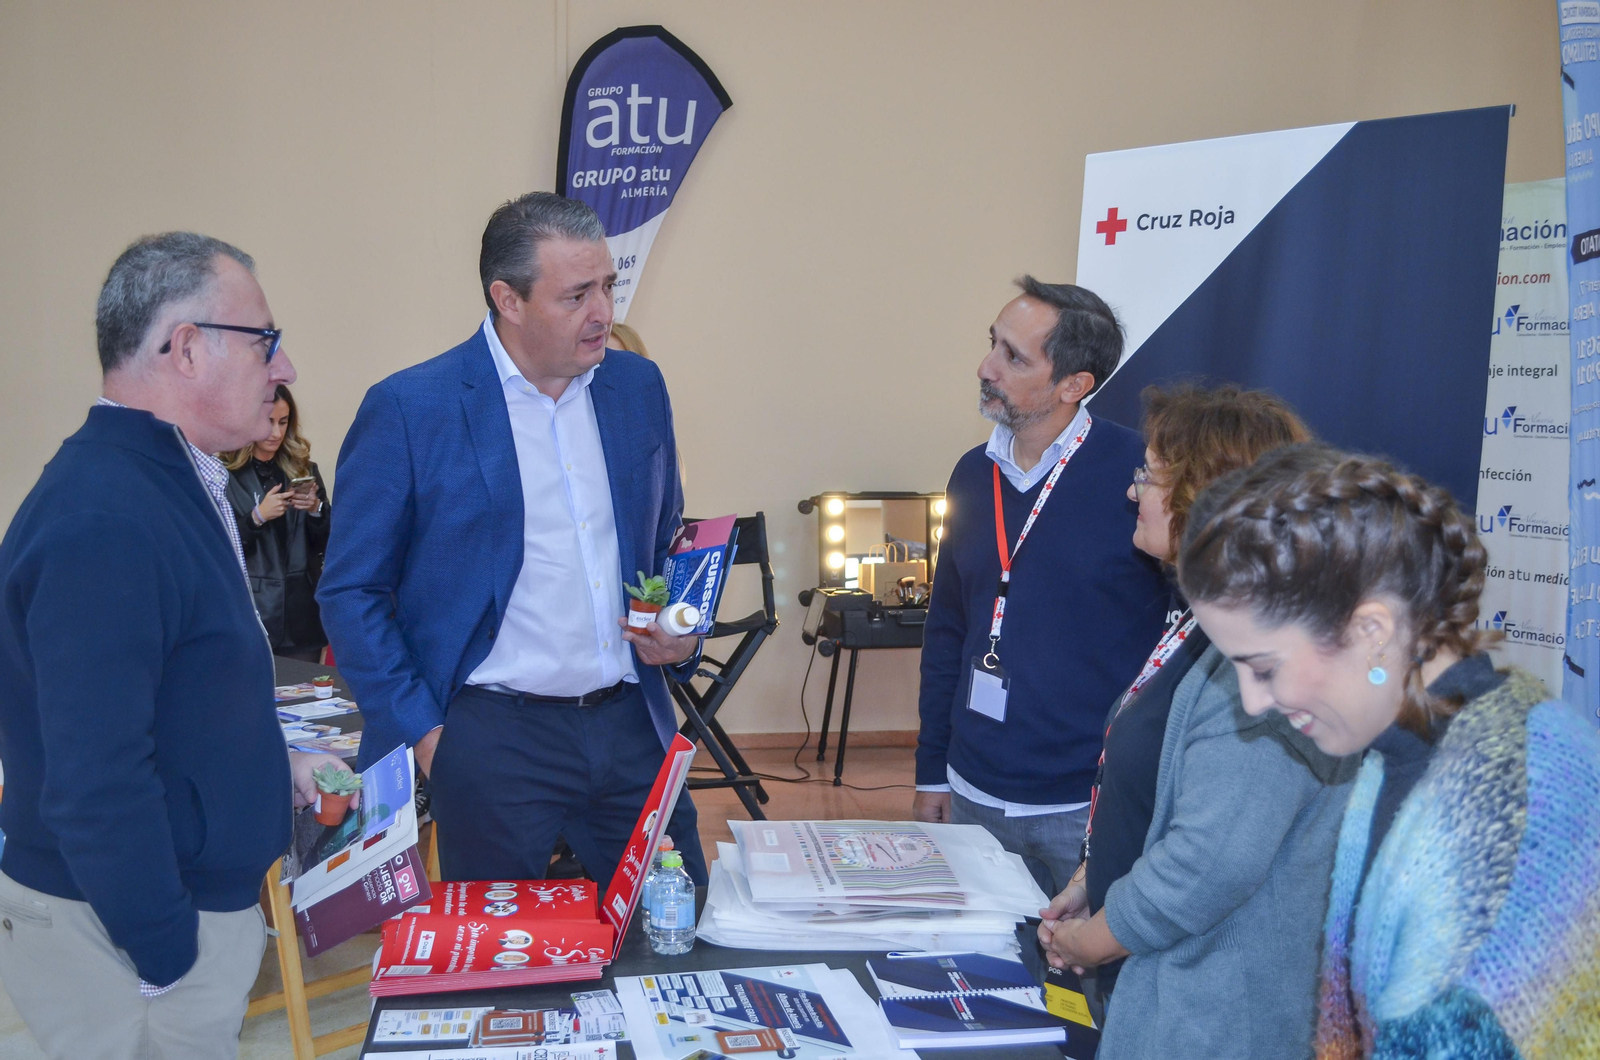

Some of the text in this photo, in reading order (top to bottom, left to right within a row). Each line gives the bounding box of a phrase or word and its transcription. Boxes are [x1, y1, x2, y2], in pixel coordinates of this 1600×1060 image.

[588, 86, 623, 97] GRUPO
[585, 84, 698, 149] atu
[611, 144, 662, 156] FORMACIÓN
[572, 164, 671, 188] GRUPO atu
[621, 184, 668, 199] ALMERÍA
[1137, 205, 1235, 231] Cruz Roja
[1507, 364, 1558, 379] integral
[1486, 565, 1505, 579] ión
[697, 551, 721, 627] CURSOS
[380, 891, 388, 905] ON
[456, 925, 466, 942] sexo
[468, 921, 489, 938] Sin
